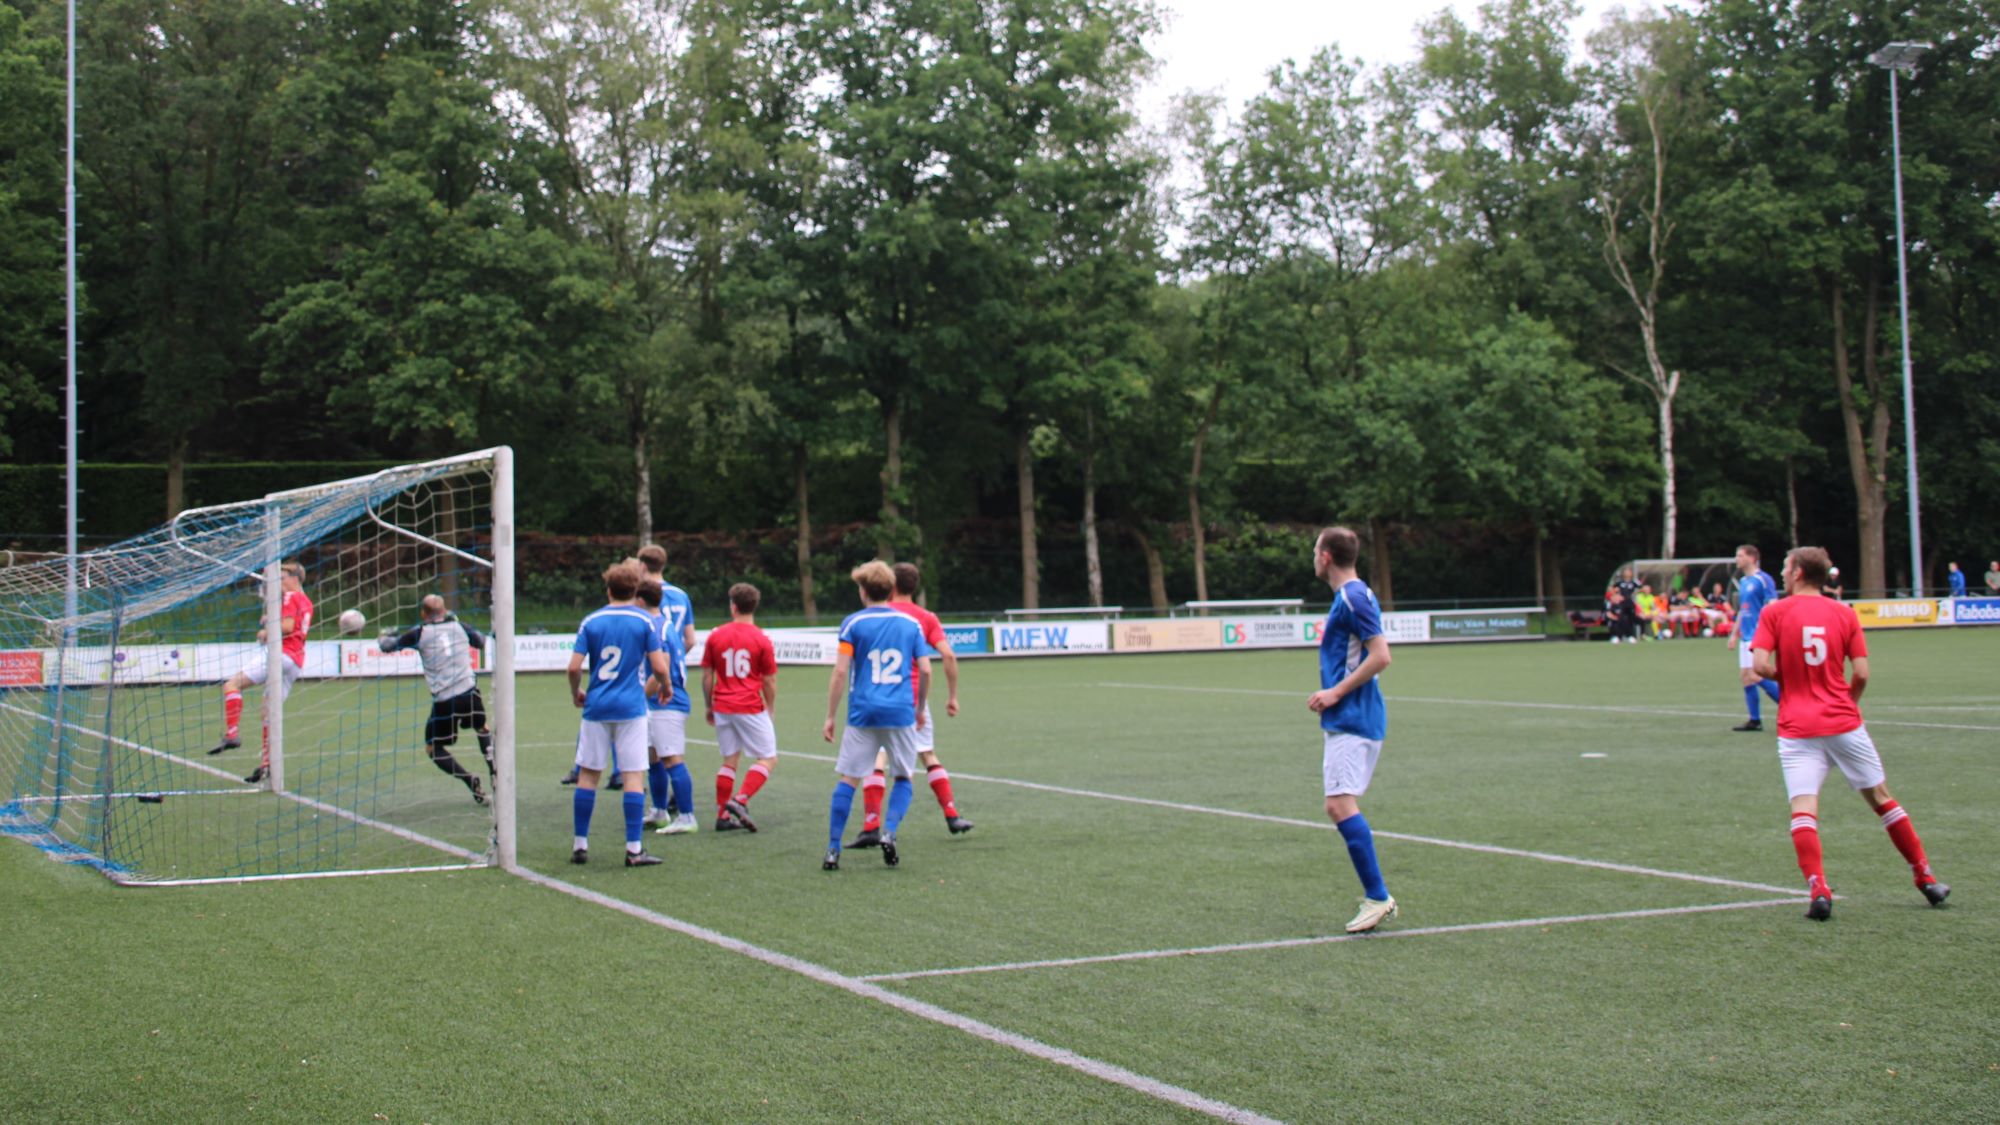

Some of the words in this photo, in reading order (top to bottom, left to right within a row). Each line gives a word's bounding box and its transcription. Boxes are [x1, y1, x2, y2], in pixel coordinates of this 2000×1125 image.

[662, 605, 687, 633] 17
[1877, 603, 1931, 618] JUMBO
[438, 631, 452, 656] 1
[1000, 627, 1068, 648] MFW
[1224, 623, 1247, 644] DS
[1802, 625, 1827, 666] 5
[597, 645, 622, 681] 2
[721, 647, 752, 679] 16
[867, 648, 903, 685] 12
